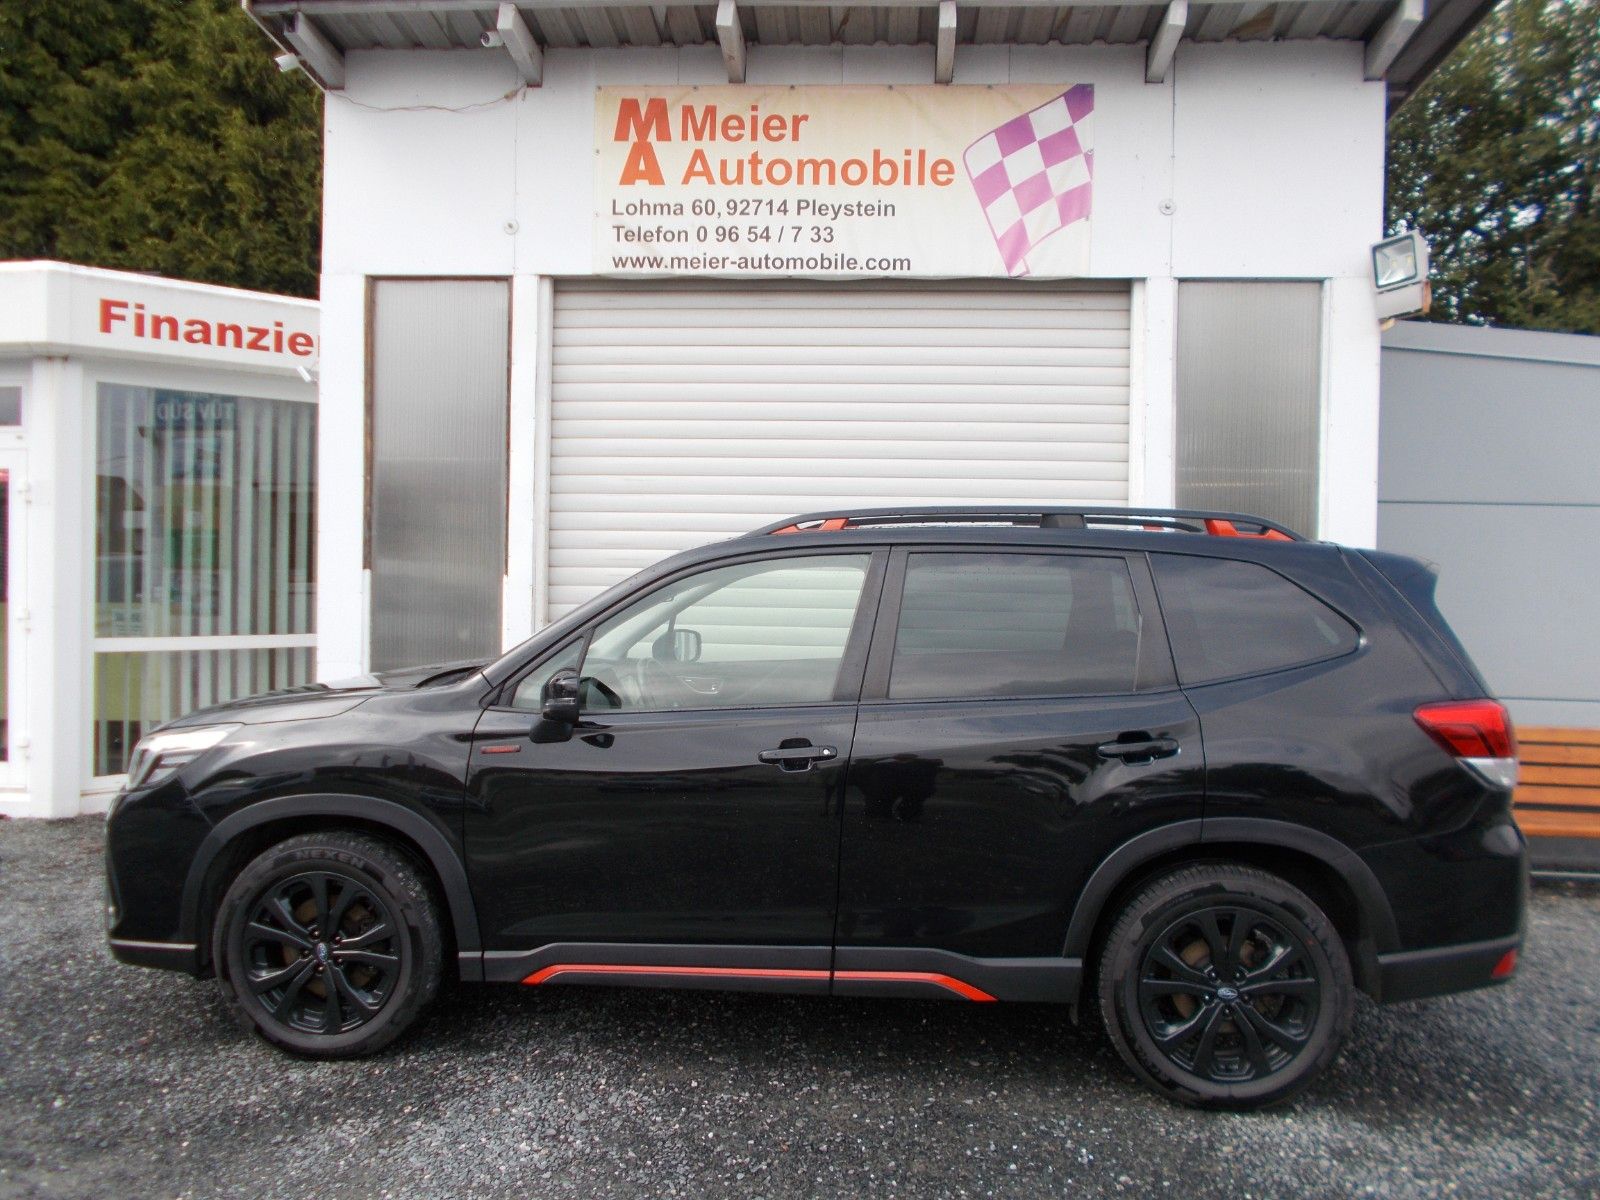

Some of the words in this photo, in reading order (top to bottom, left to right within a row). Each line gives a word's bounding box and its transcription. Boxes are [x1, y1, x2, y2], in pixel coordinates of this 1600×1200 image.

[681, 104, 810, 142] Meier
[681, 148, 956, 186] Automobile
[612, 198, 684, 216] Lohma
[796, 199, 896, 221] Pleystein
[612, 226, 689, 242] Telefon
[696, 226, 708, 243] 0
[715, 226, 740, 243] 96
[747, 226, 772, 243] 54
[778, 226, 784, 243] /
[791, 226, 803, 243] 7
[810, 226, 835, 243] 33
[612, 253, 911, 271] www.meier-automobile.com
[99, 298, 320, 357] Finanzie
